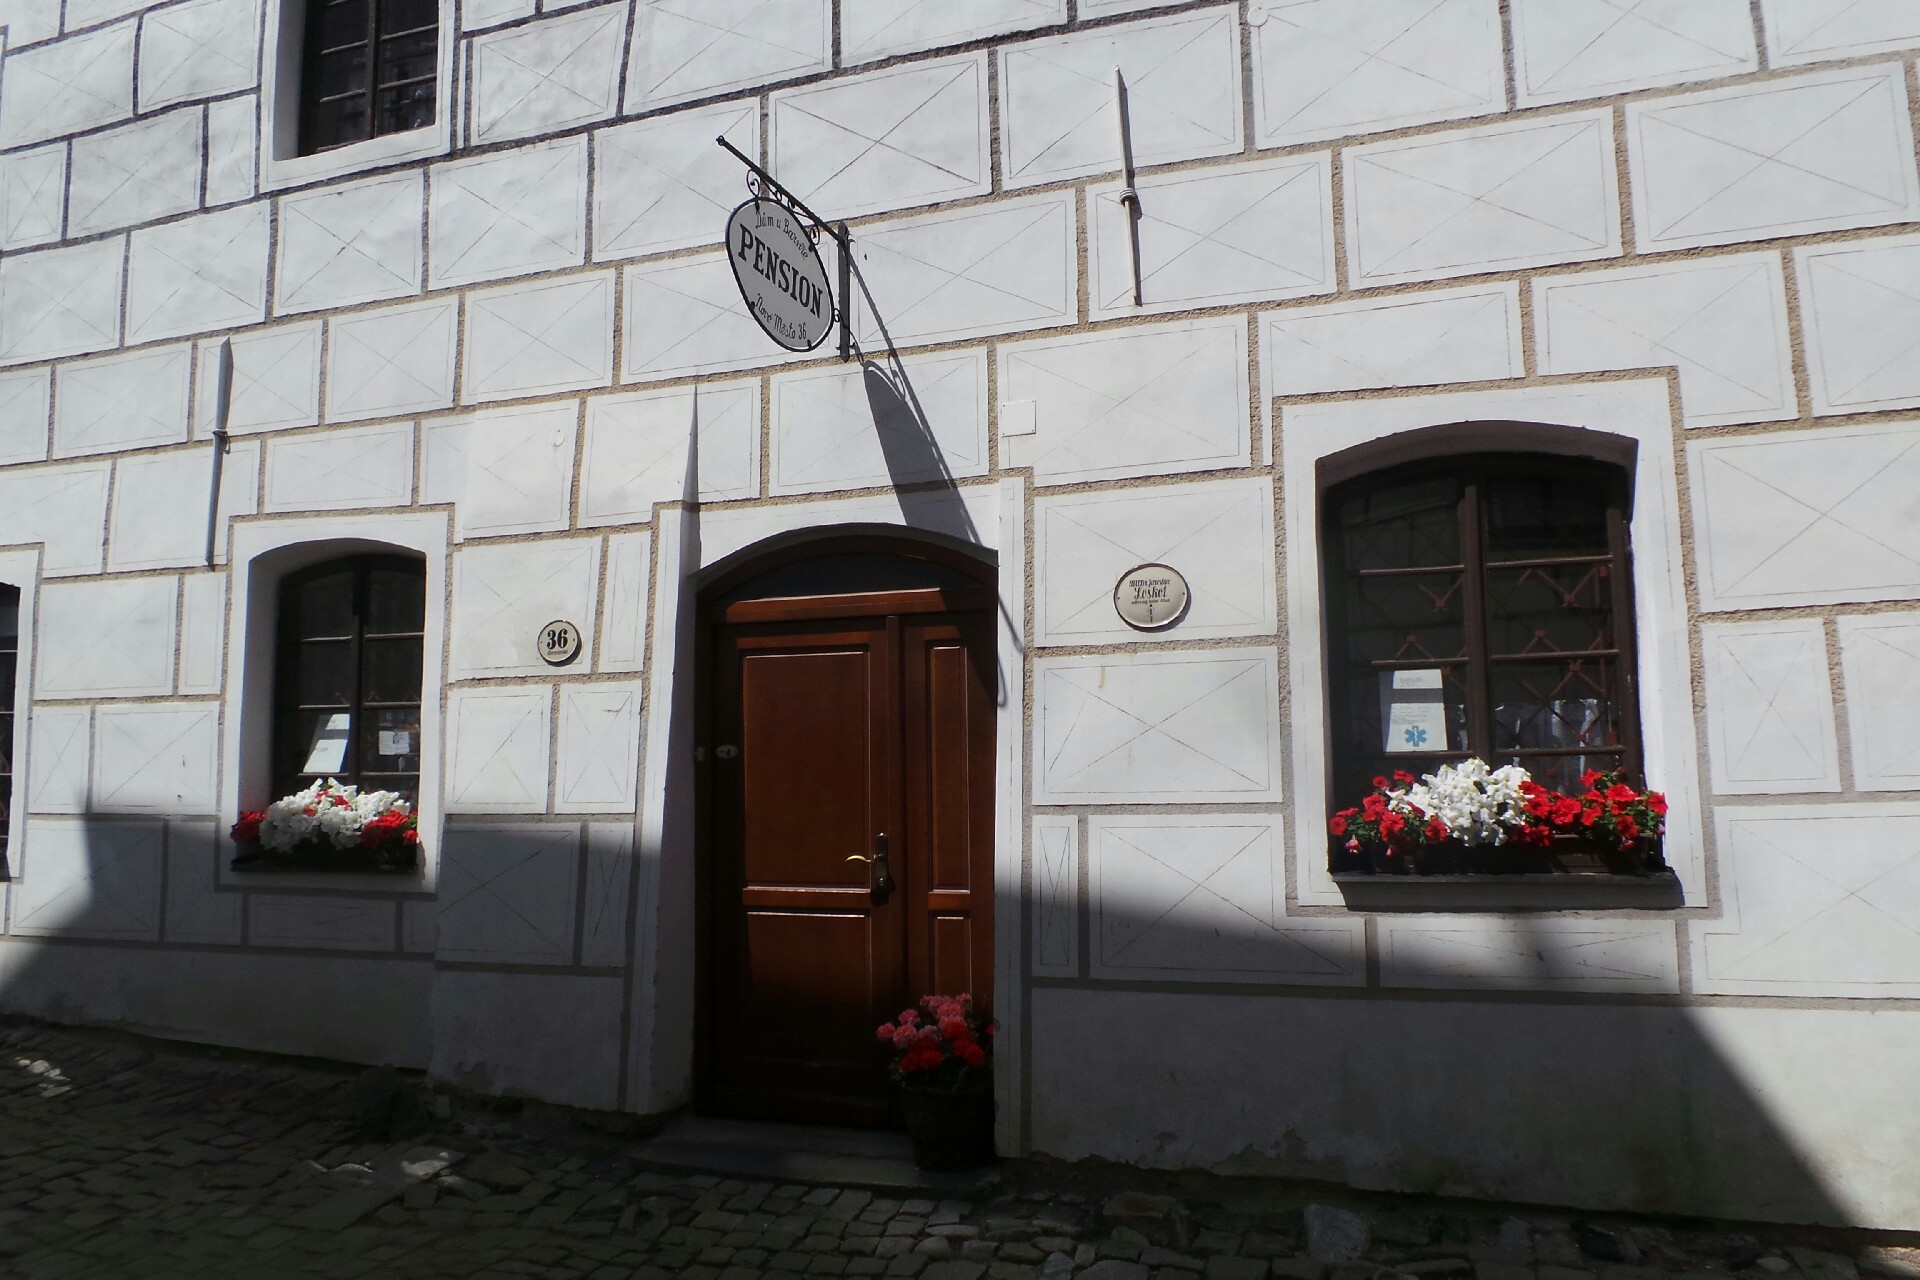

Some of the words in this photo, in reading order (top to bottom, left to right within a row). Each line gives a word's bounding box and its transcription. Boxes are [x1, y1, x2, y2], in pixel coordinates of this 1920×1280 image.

[738, 223, 823, 318] PENSION
[798, 322, 806, 340] 36
[547, 629, 568, 650] 36
